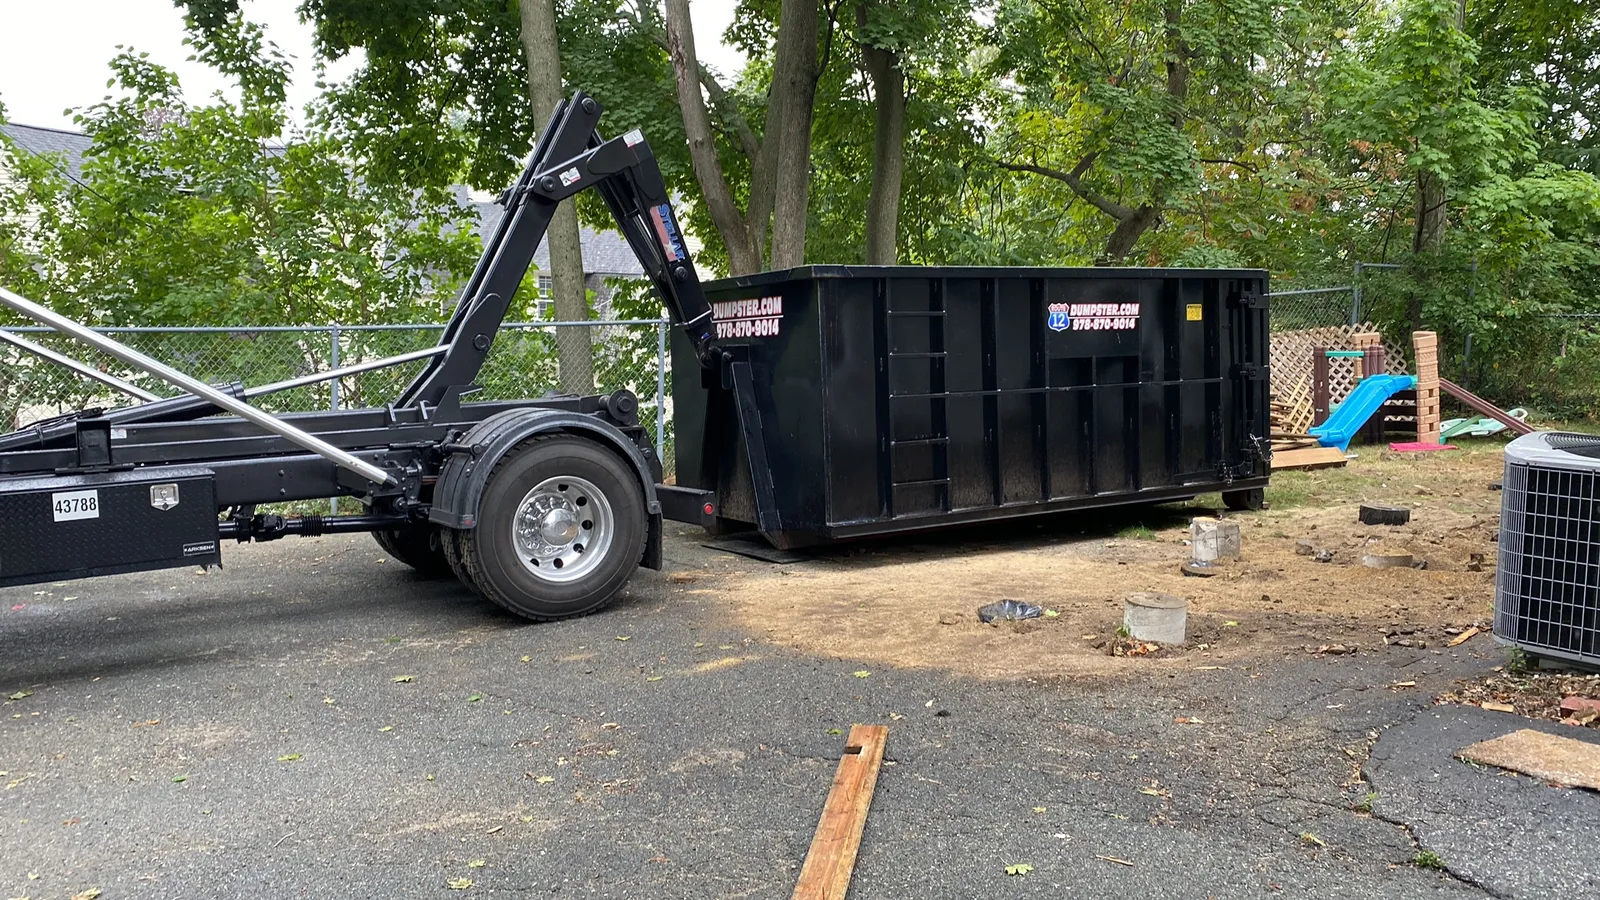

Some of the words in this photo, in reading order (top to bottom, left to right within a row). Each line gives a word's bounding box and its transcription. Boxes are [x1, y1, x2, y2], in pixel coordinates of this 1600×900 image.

[658, 204, 685, 260] STELLAR
[712, 296, 782, 319] DUMPSTER.COM
[1069, 303, 1140, 316] DUMPSTER.COM
[716, 318, 780, 339] 978-870-9014
[1052, 313, 1066, 327] 12
[1072, 318, 1136, 330] 978-870-9014
[54, 497, 97, 514] 43788
